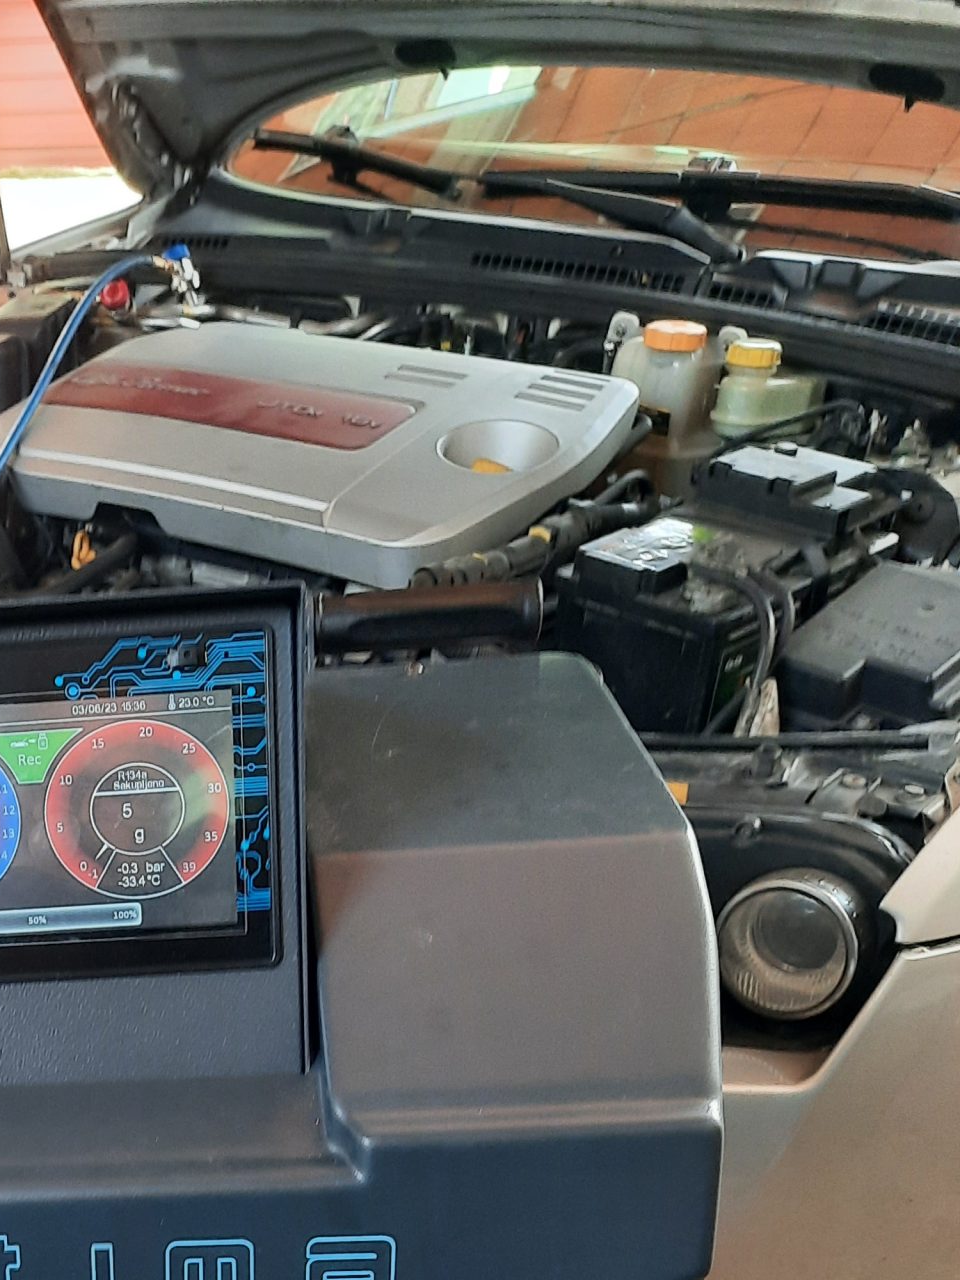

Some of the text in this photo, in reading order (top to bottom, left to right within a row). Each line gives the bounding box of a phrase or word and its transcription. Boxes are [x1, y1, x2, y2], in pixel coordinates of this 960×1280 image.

[139, 726, 153, 738] 20
[92, 738, 105, 749] 15
[182, 743, 196, 754] 25
[18, 753, 42, 766] Rec
[59, 774, 73, 786] 10
[207, 782, 222, 794] 30
[3, 805, 16, 816] 12
[122, 803, 133, 819] 5
[56, 822, 64, 833] 5
[2, 828, 16, 839] 13
[134, 828, 145, 844] g
[204, 831, 218, 842] 35
[79, 861, 87, 872] 0
[117, 861, 166, 875] -0.3 bar
[182, 861, 196, 873] 39
[89, 869, 99, 880] -1
[27, 915, 47, 926] 50%
[113, 909, 138, 921] 100%
